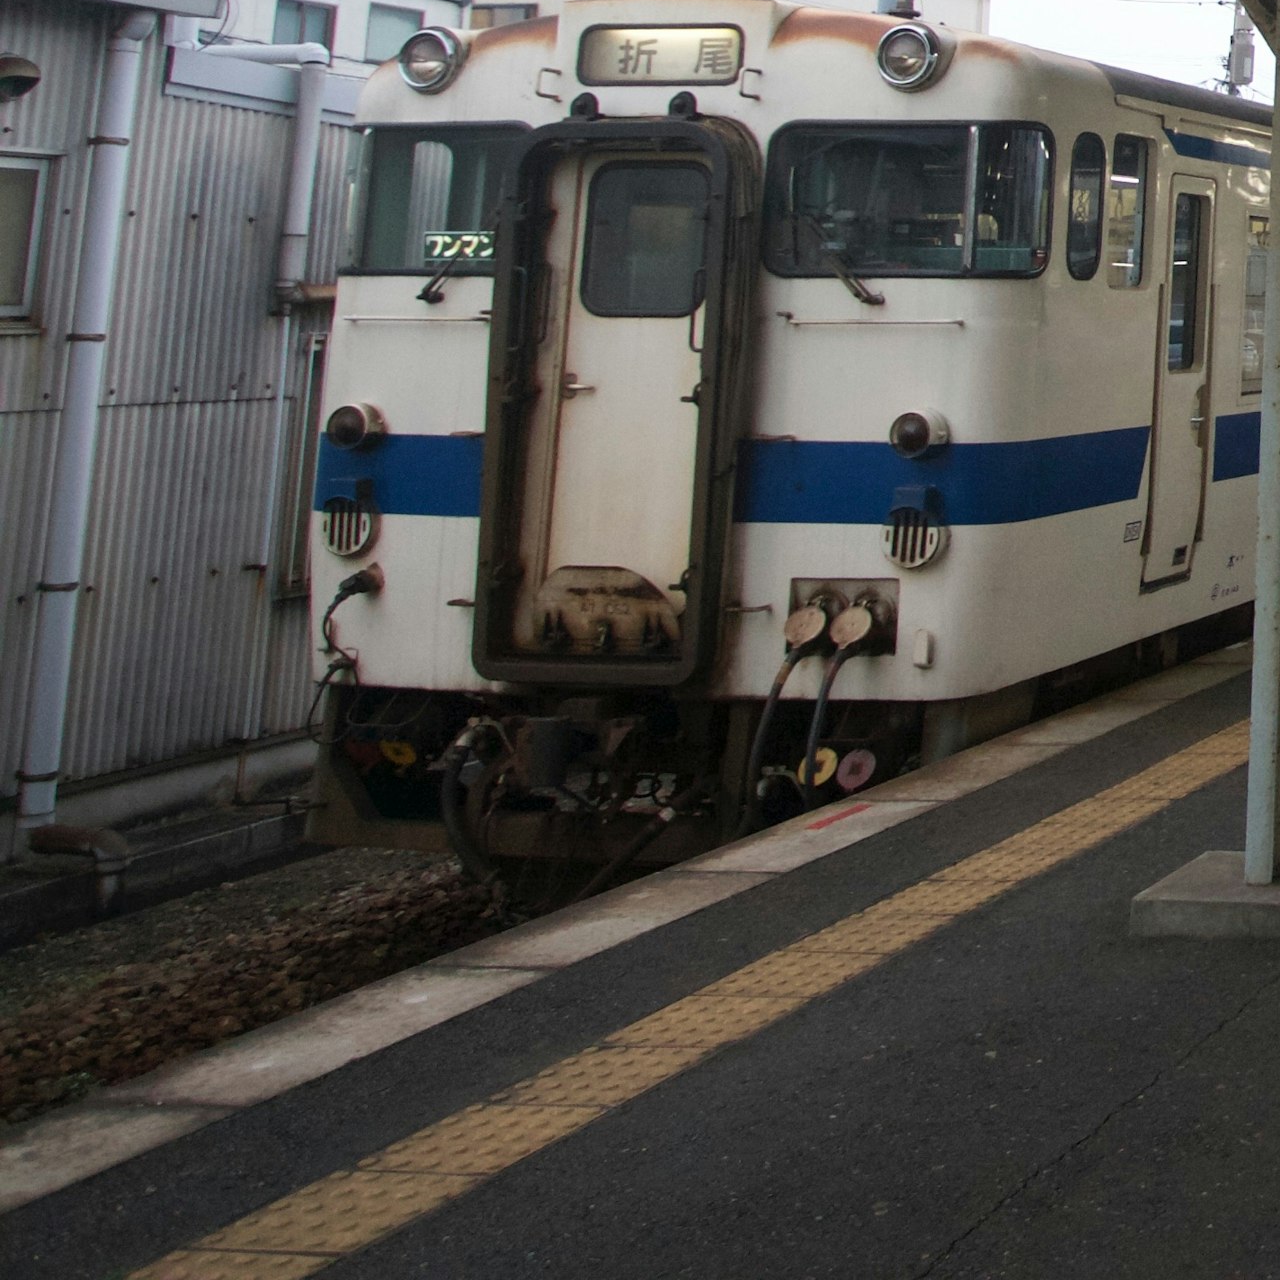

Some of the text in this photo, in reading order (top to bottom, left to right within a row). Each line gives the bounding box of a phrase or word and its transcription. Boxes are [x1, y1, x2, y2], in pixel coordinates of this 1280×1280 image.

[618, 37, 734, 74] 折尾
[425, 235, 494, 257] ワンマン
